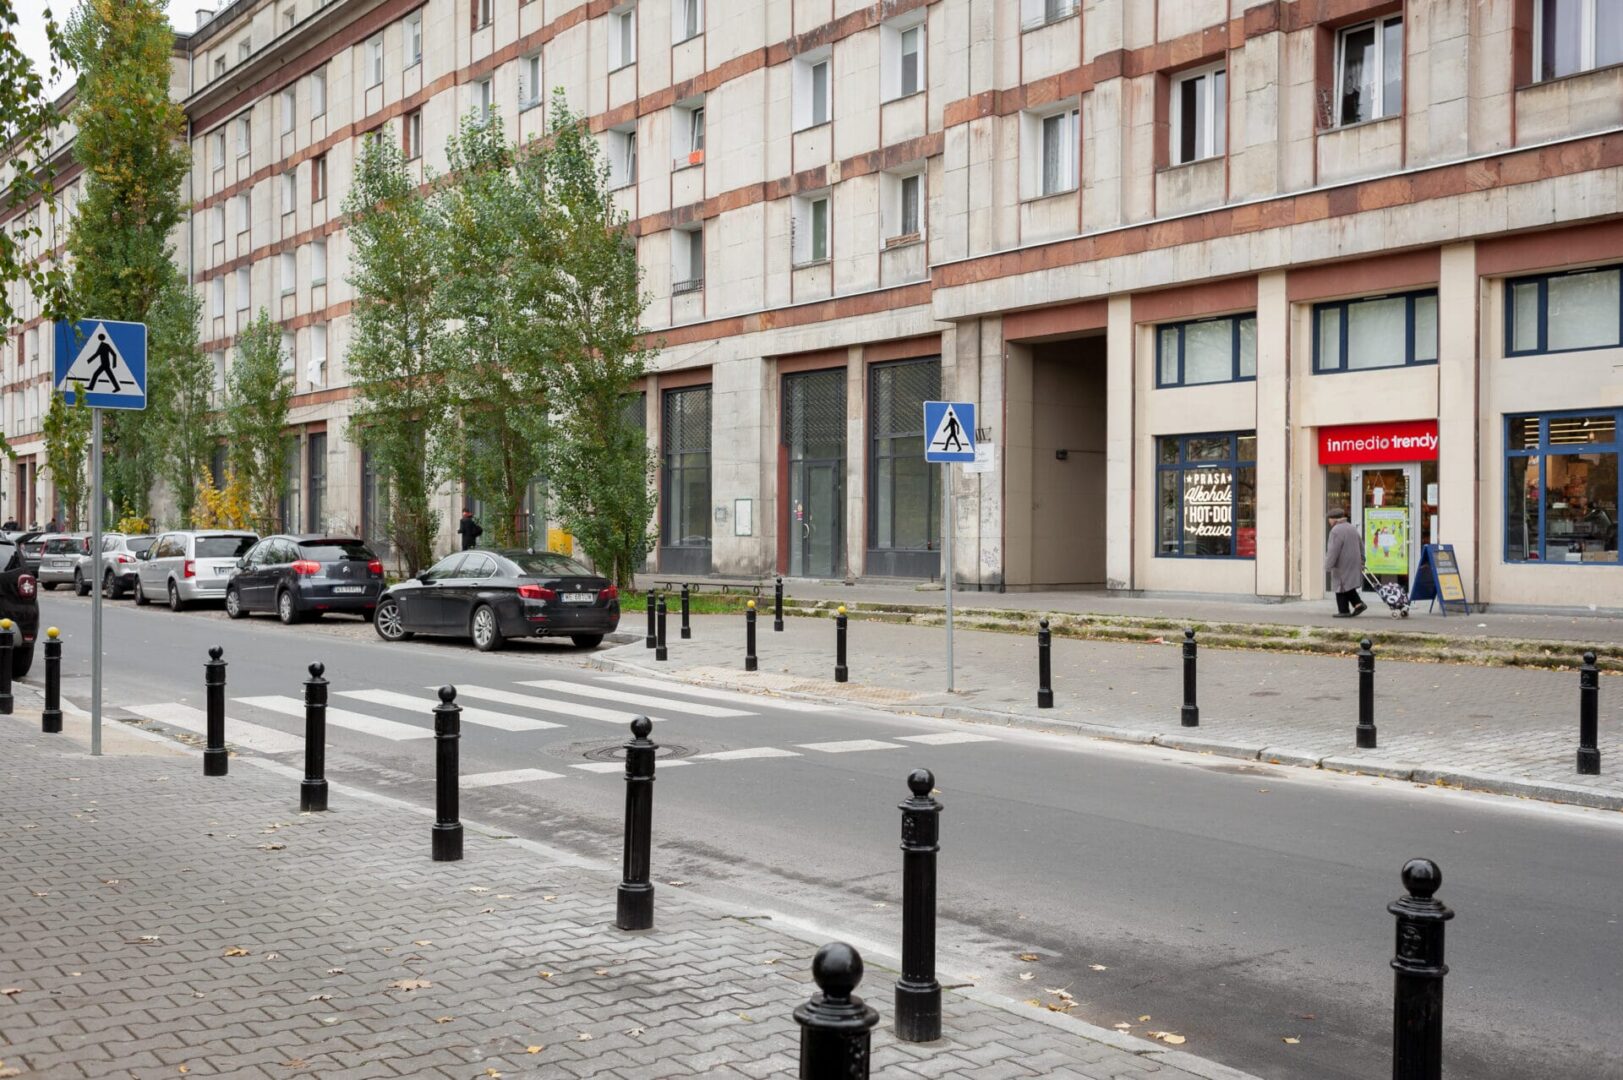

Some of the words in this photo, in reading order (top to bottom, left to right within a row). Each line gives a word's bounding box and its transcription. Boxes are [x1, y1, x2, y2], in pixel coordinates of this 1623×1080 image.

[1327, 435, 1389, 452] inmedio
[1392, 432, 1438, 450] trendy
[1194, 473, 1226, 485] PRASA
[1195, 522, 1232, 536] kawa
